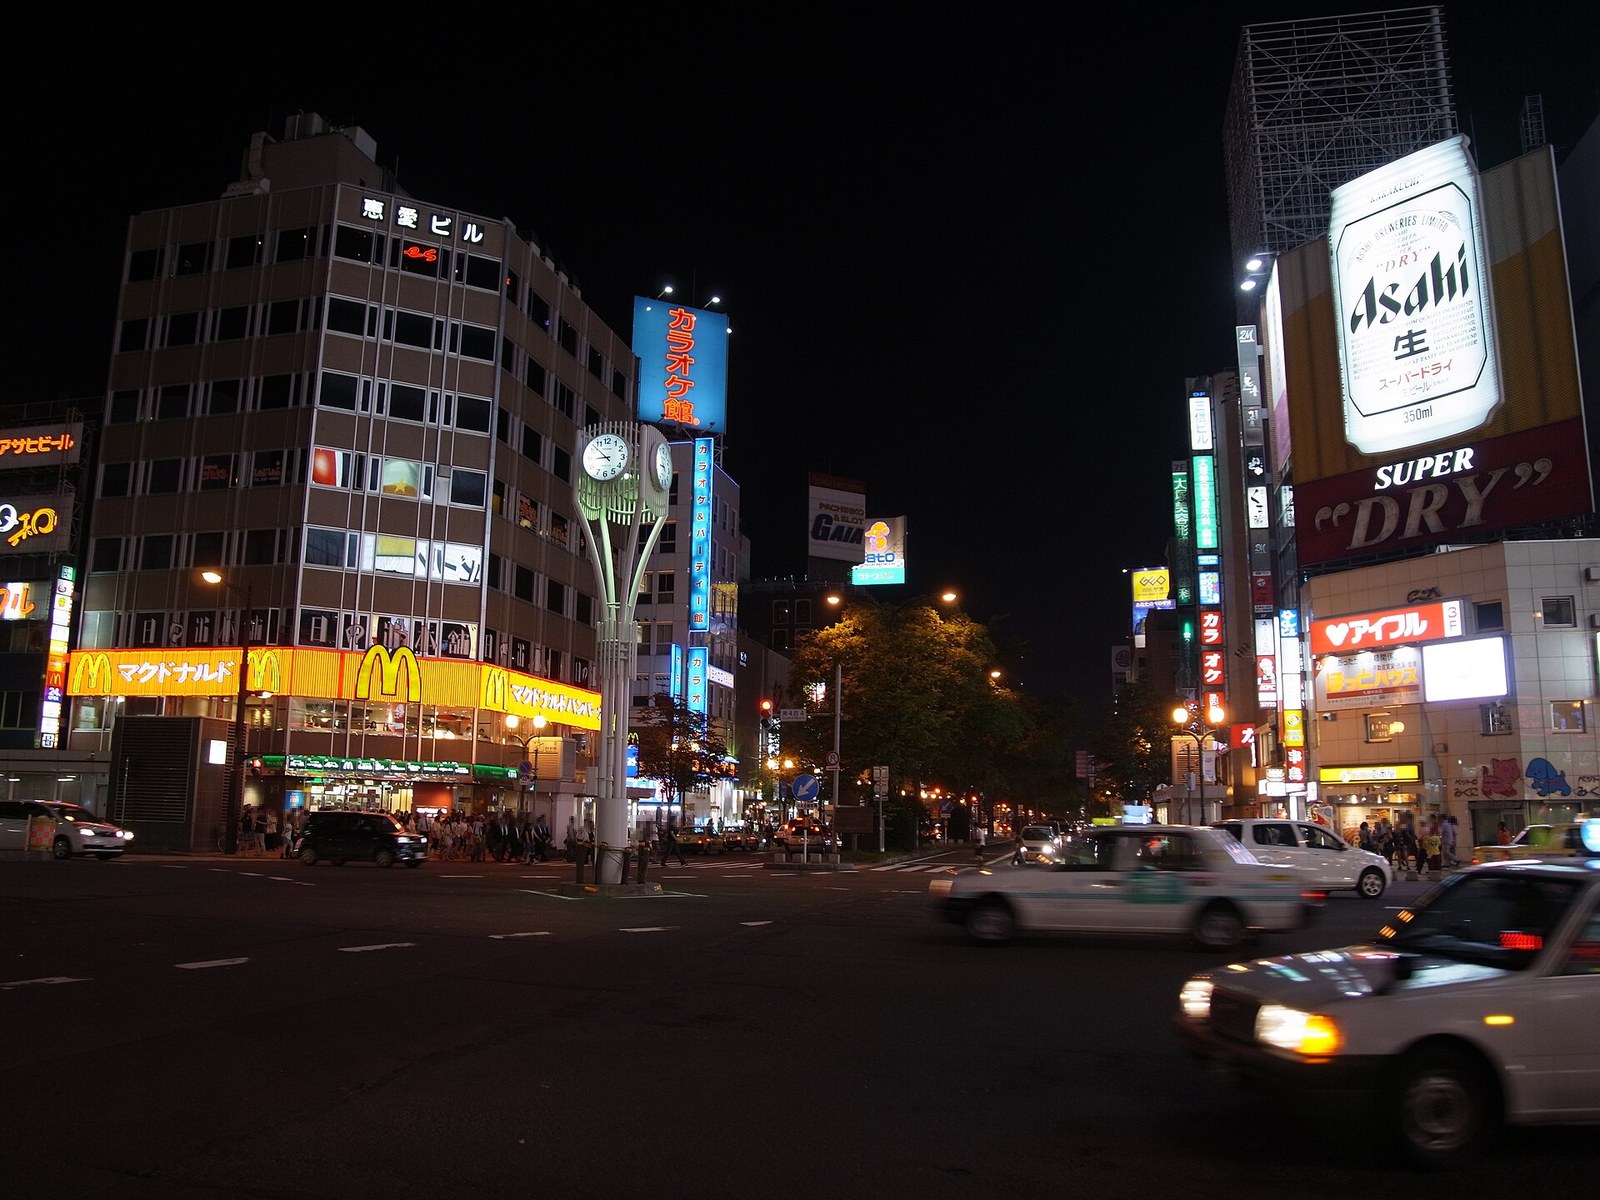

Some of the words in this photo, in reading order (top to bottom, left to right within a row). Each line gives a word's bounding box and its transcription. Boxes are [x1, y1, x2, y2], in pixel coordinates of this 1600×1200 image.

[363, 198, 484, 243] 恵愛ビル
[1374, 215, 1418, 241] BREWERIES
[1421, 215, 1449, 233] LIMITED
[1350, 242, 1469, 334] Asahi
[1393, 329, 1430, 360] 生
[664, 308, 697, 424] カラオケ館
[1379, 359, 1453, 390] スーパードライ
[1402, 405, 1434, 424] 350ml
[0, 434, 75, 455] アサヒビール
[1374, 447, 1475, 491] SUPER
[819, 502, 865, 516] PACHINKO
[811, 513, 866, 545] GAIA
[1348, 611, 1428, 644] アイフル
[117, 661, 235, 684] マクドナルド
[1325, 668, 1419, 693] ほっとハウス
[1454, 787, 1479, 798] みくに
